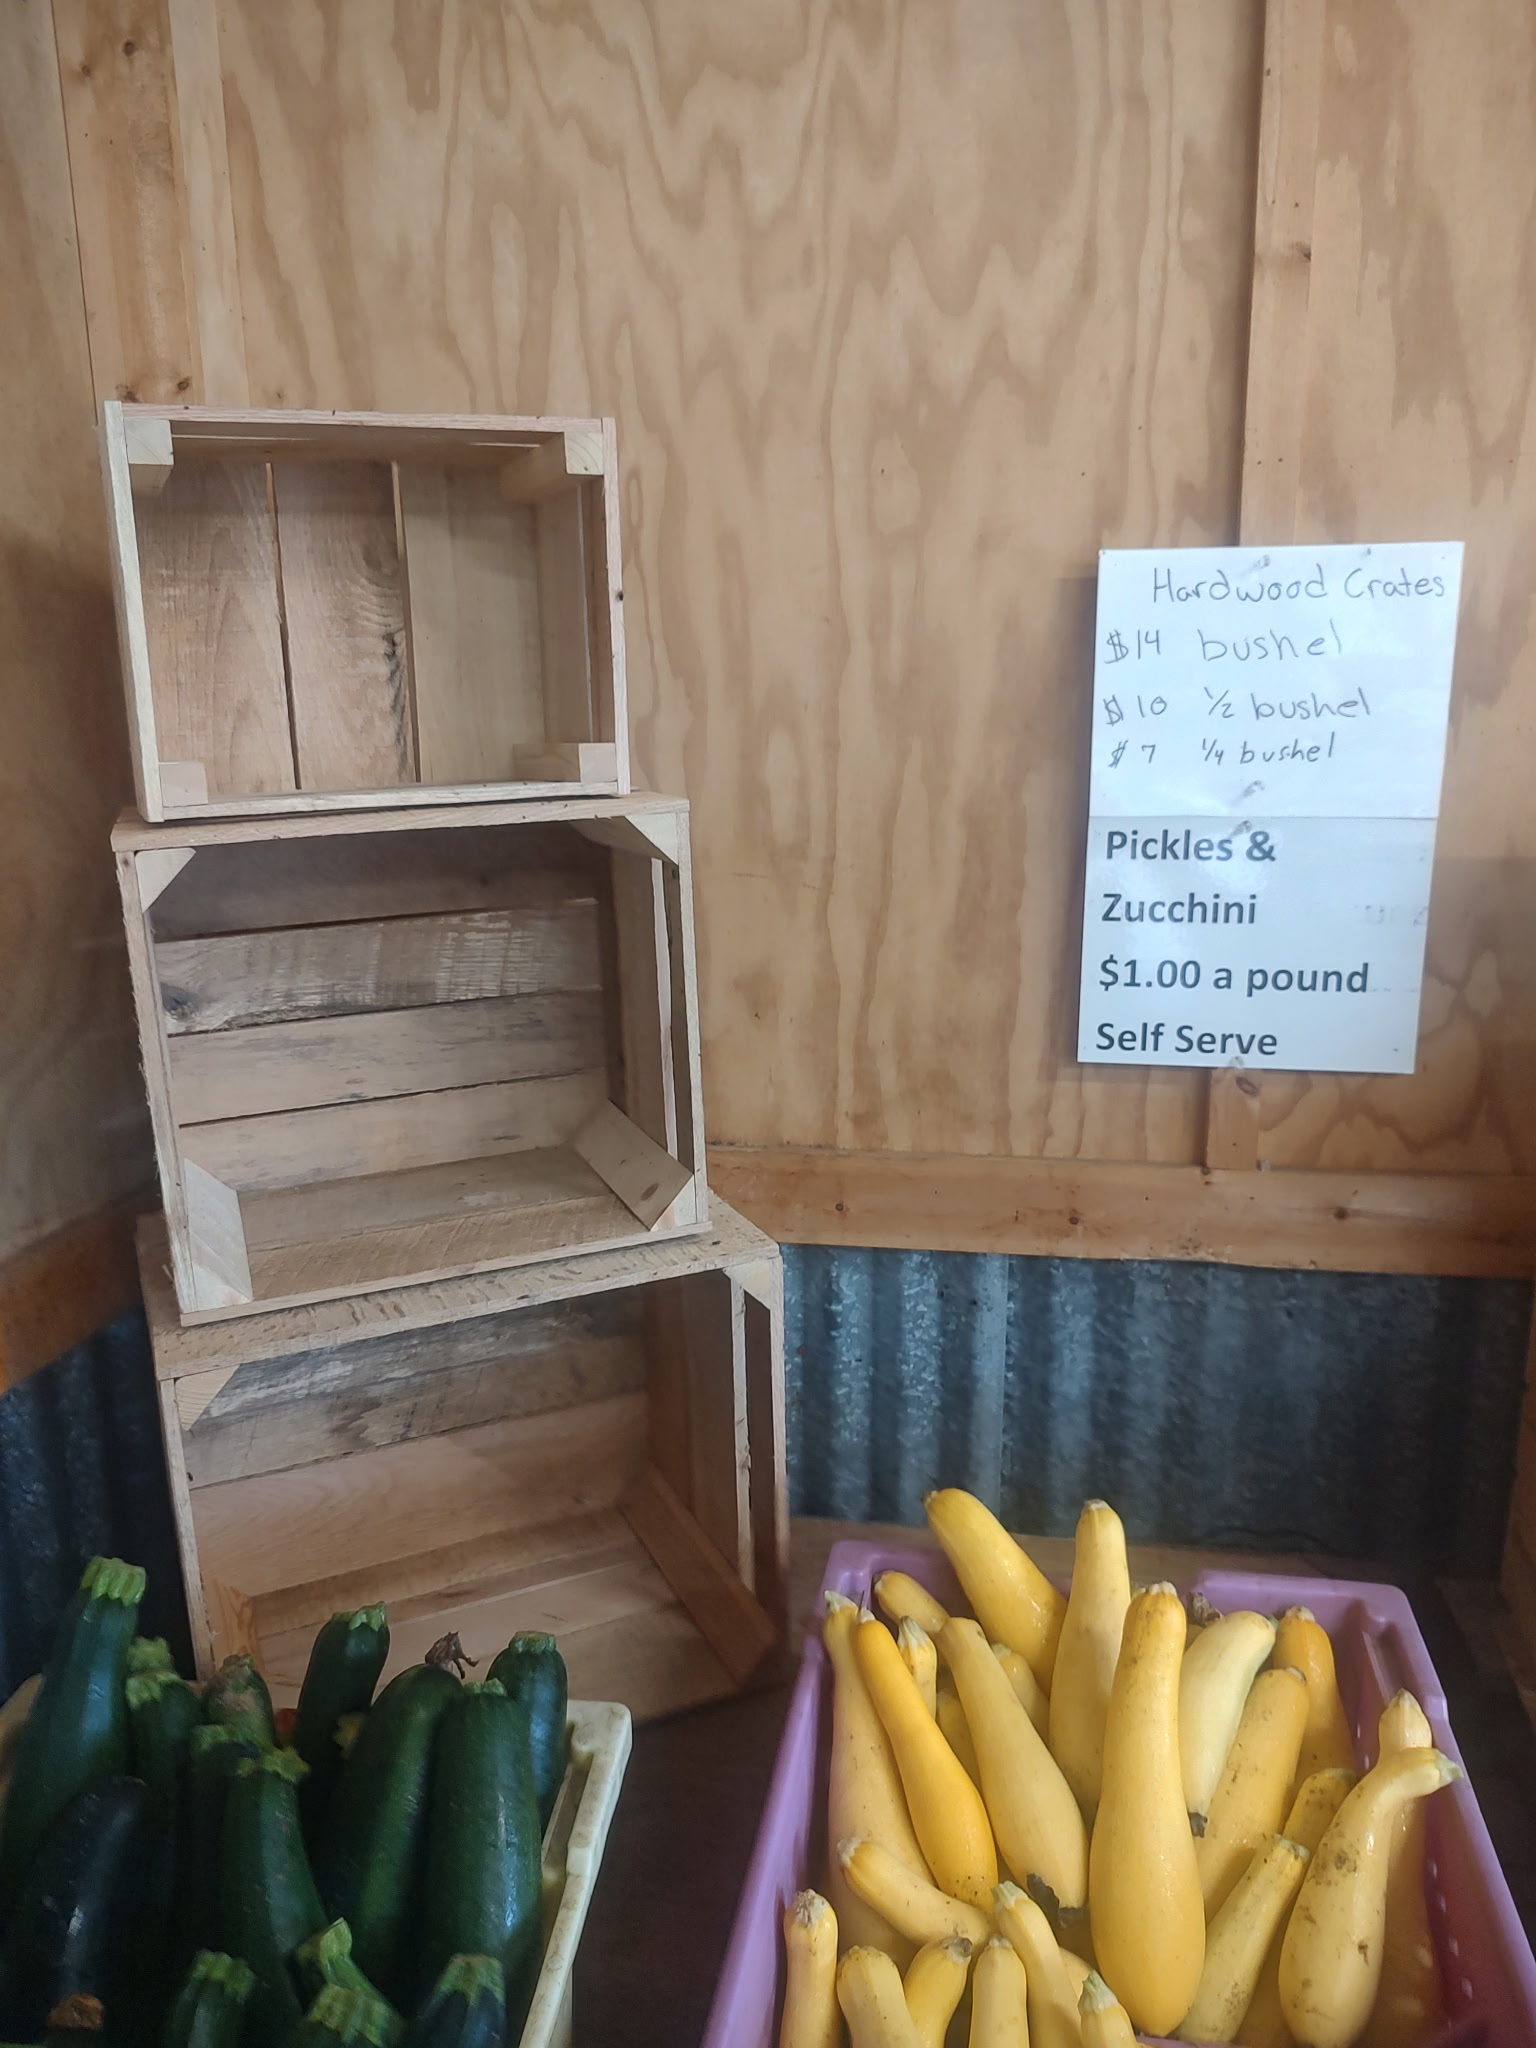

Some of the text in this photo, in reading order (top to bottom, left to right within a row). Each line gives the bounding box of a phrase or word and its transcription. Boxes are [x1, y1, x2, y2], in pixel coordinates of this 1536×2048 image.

[1153, 563, 1446, 602] Hardwood Crates
[1104, 618, 1342, 664] $14 bushel
[1250, 686, 1371, 721] bushel
[1240, 731, 1336, 766] bushel
[1105, 829, 1276, 862] Pickles &
[1101, 892, 1257, 924] Zucchini
[1098, 954, 1369, 998] $1.00 a pound
[1095, 1022, 1278, 1056] Self Serve
